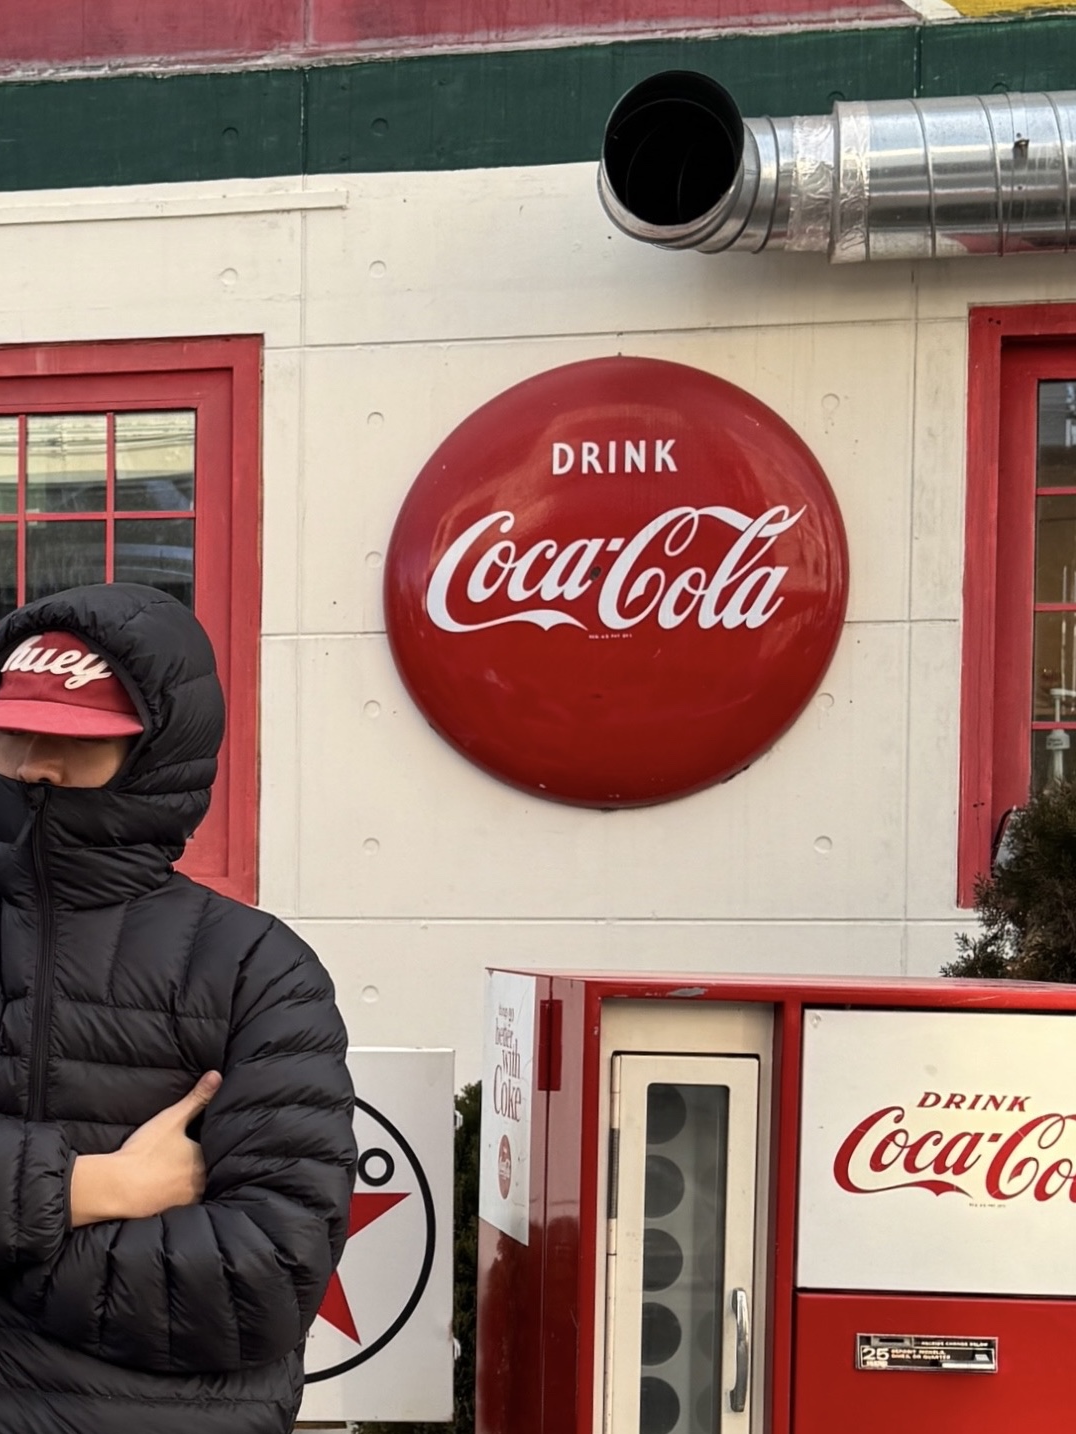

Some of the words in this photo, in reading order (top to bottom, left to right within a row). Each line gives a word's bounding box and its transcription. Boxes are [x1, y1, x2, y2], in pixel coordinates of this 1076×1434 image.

[552, 439, 678, 475] DRINK
[426, 503, 807, 633] Coca-Cola
[501, 1038, 521, 1081] with
[493, 1064, 522, 1122] Coke
[916, 1091, 1031, 1112] DRINK
[862, 1348, 889, 1360] 25
